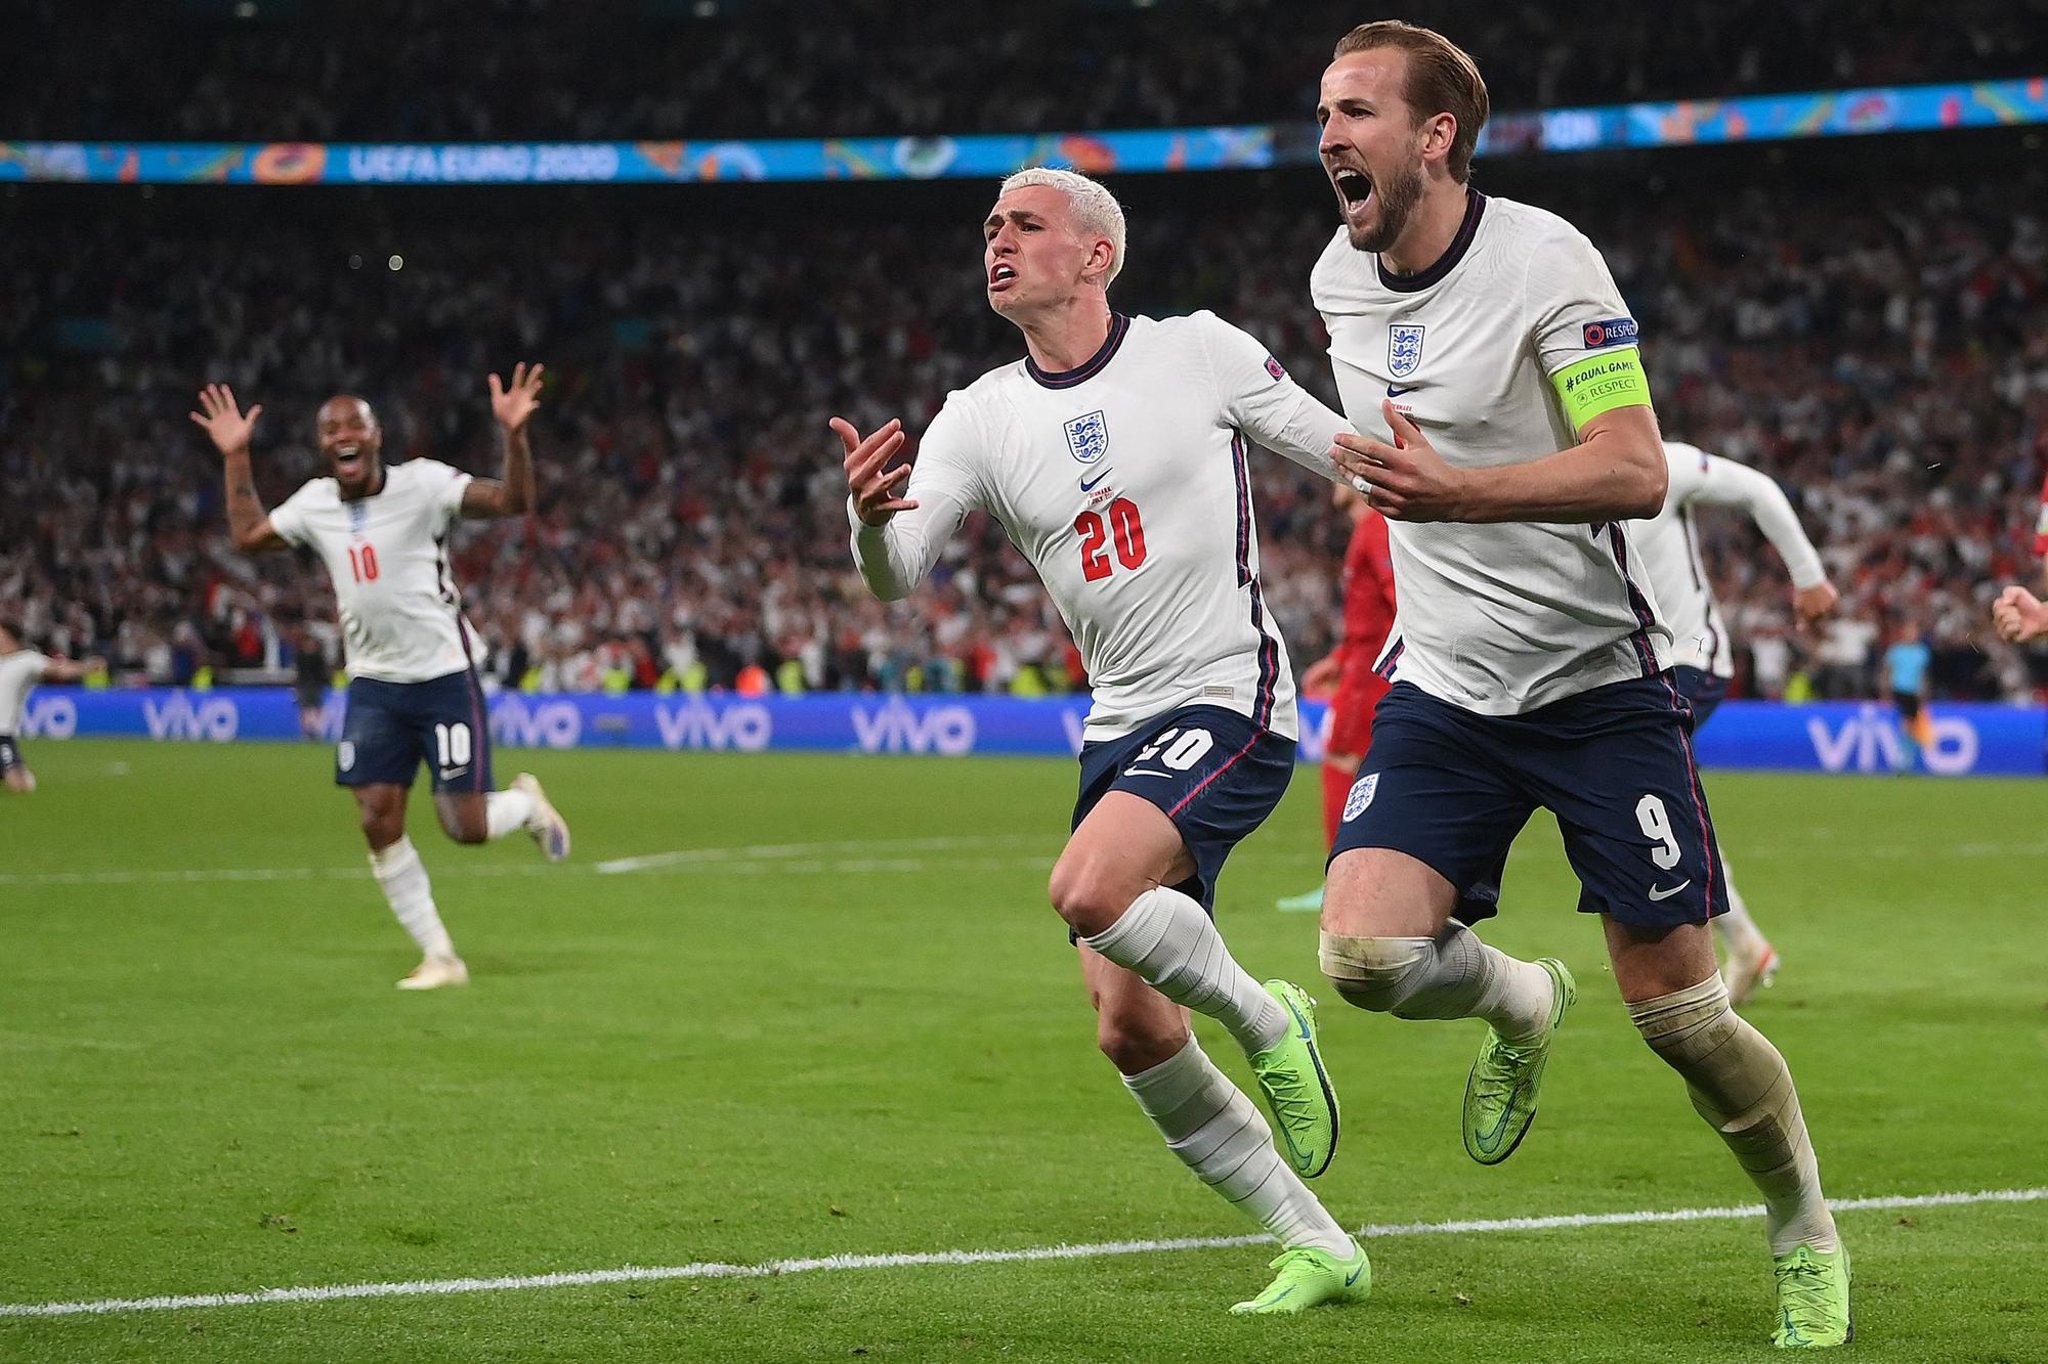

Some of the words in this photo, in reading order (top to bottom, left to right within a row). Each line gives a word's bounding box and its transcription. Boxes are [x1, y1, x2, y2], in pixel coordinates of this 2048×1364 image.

[349, 145, 437, 181] UEFA
[440, 145, 530, 181] EURO
[532, 144, 619, 181] 2020
[1605, 324, 1636, 339] RESPEC
[1565, 366, 1608, 393] #EQUAL
[1608, 361, 1635, 373] GAME
[1590, 379, 1637, 397] RESPECT
[1073, 498, 1147, 582] 20
[348, 545, 378, 583] 10
[434, 722, 471, 766] 10
[1134, 728, 1214, 770] 20
[1635, 794, 1681, 870] 9
